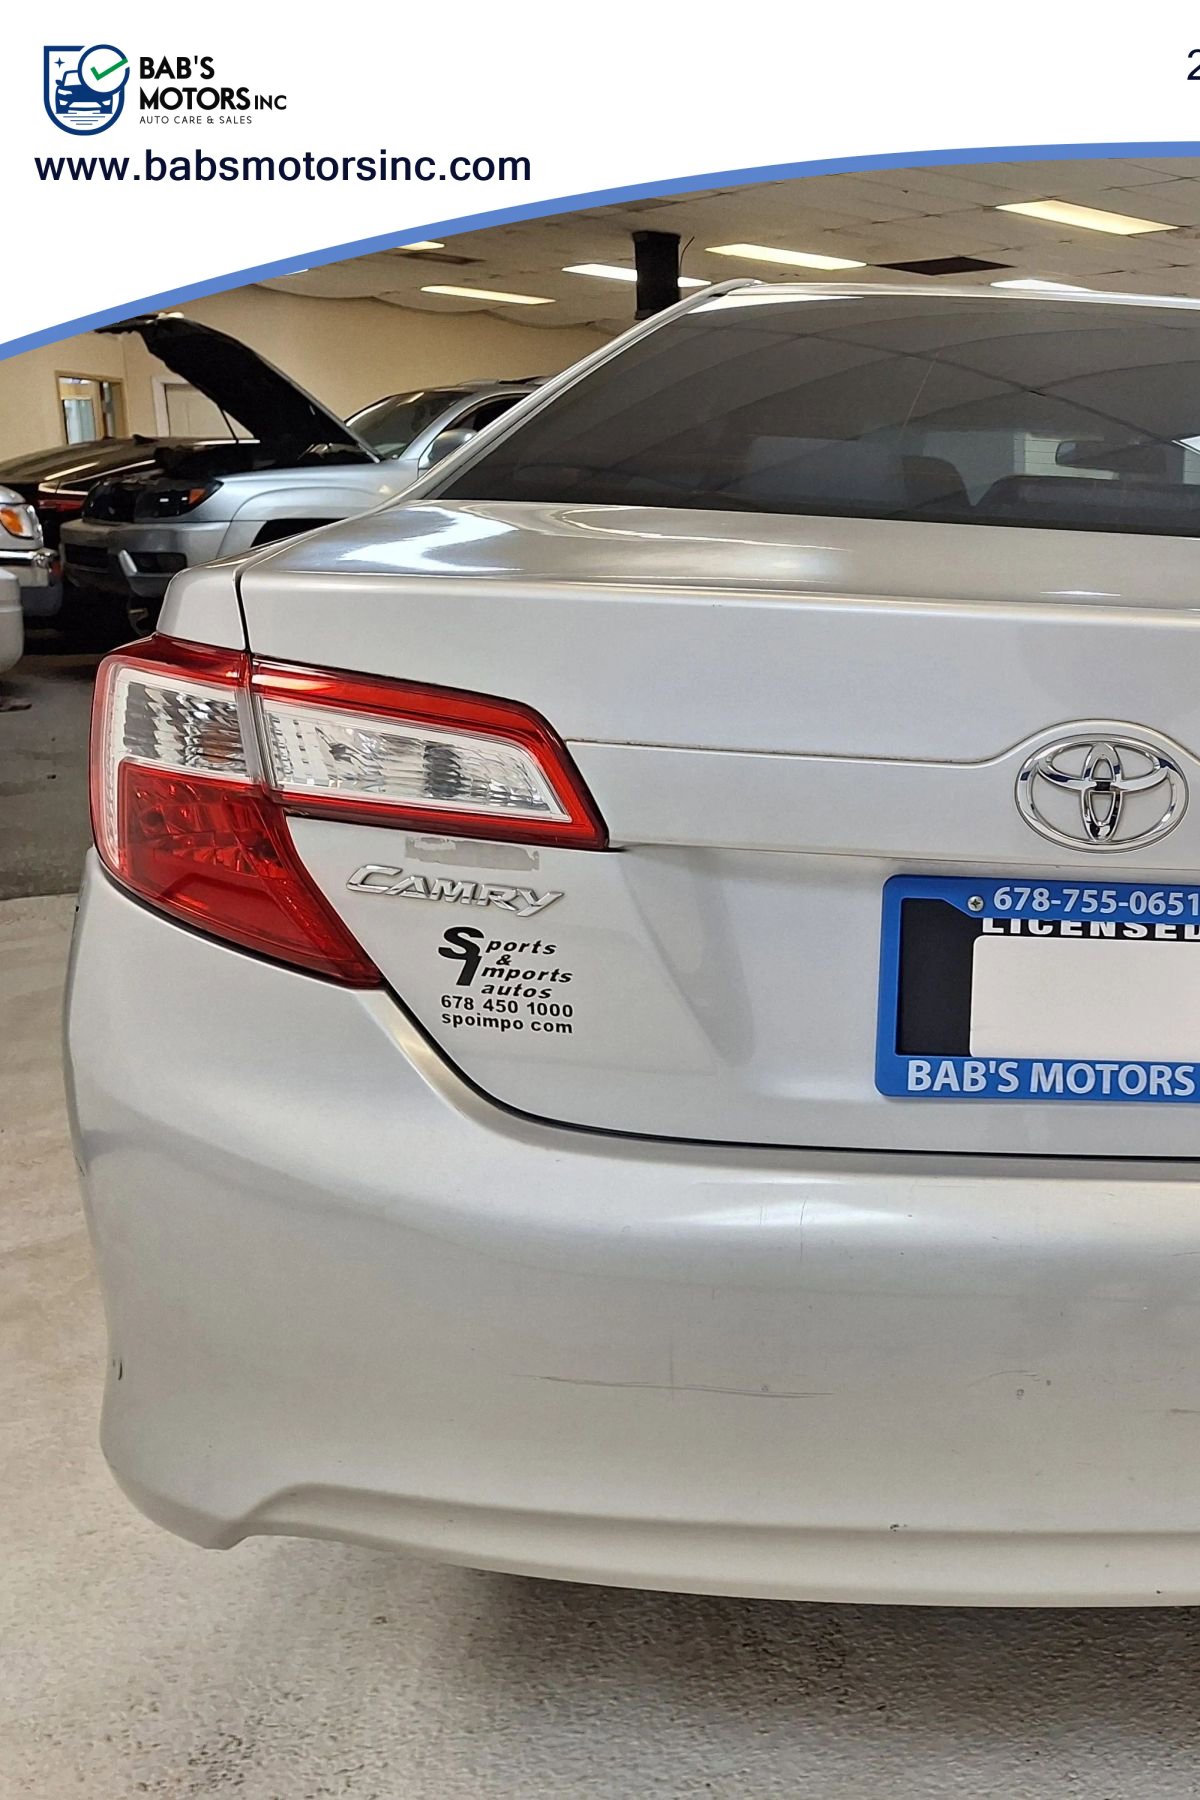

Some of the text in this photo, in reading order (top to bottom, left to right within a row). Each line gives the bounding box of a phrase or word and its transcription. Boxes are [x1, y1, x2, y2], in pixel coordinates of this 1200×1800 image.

[346, 864, 565, 917] CAMRY
[993, 886, 1200, 916] 678-755-0651
[496, 954, 512, 966] &
[481, 983, 552, 999] autos
[441, 995, 573, 1017] 678 450 1000
[441, 1012, 573, 1034] spoimpo com
[906, 1059, 1020, 1094] BAB'S
[1029, 1062, 1196, 1097] MOTORS
